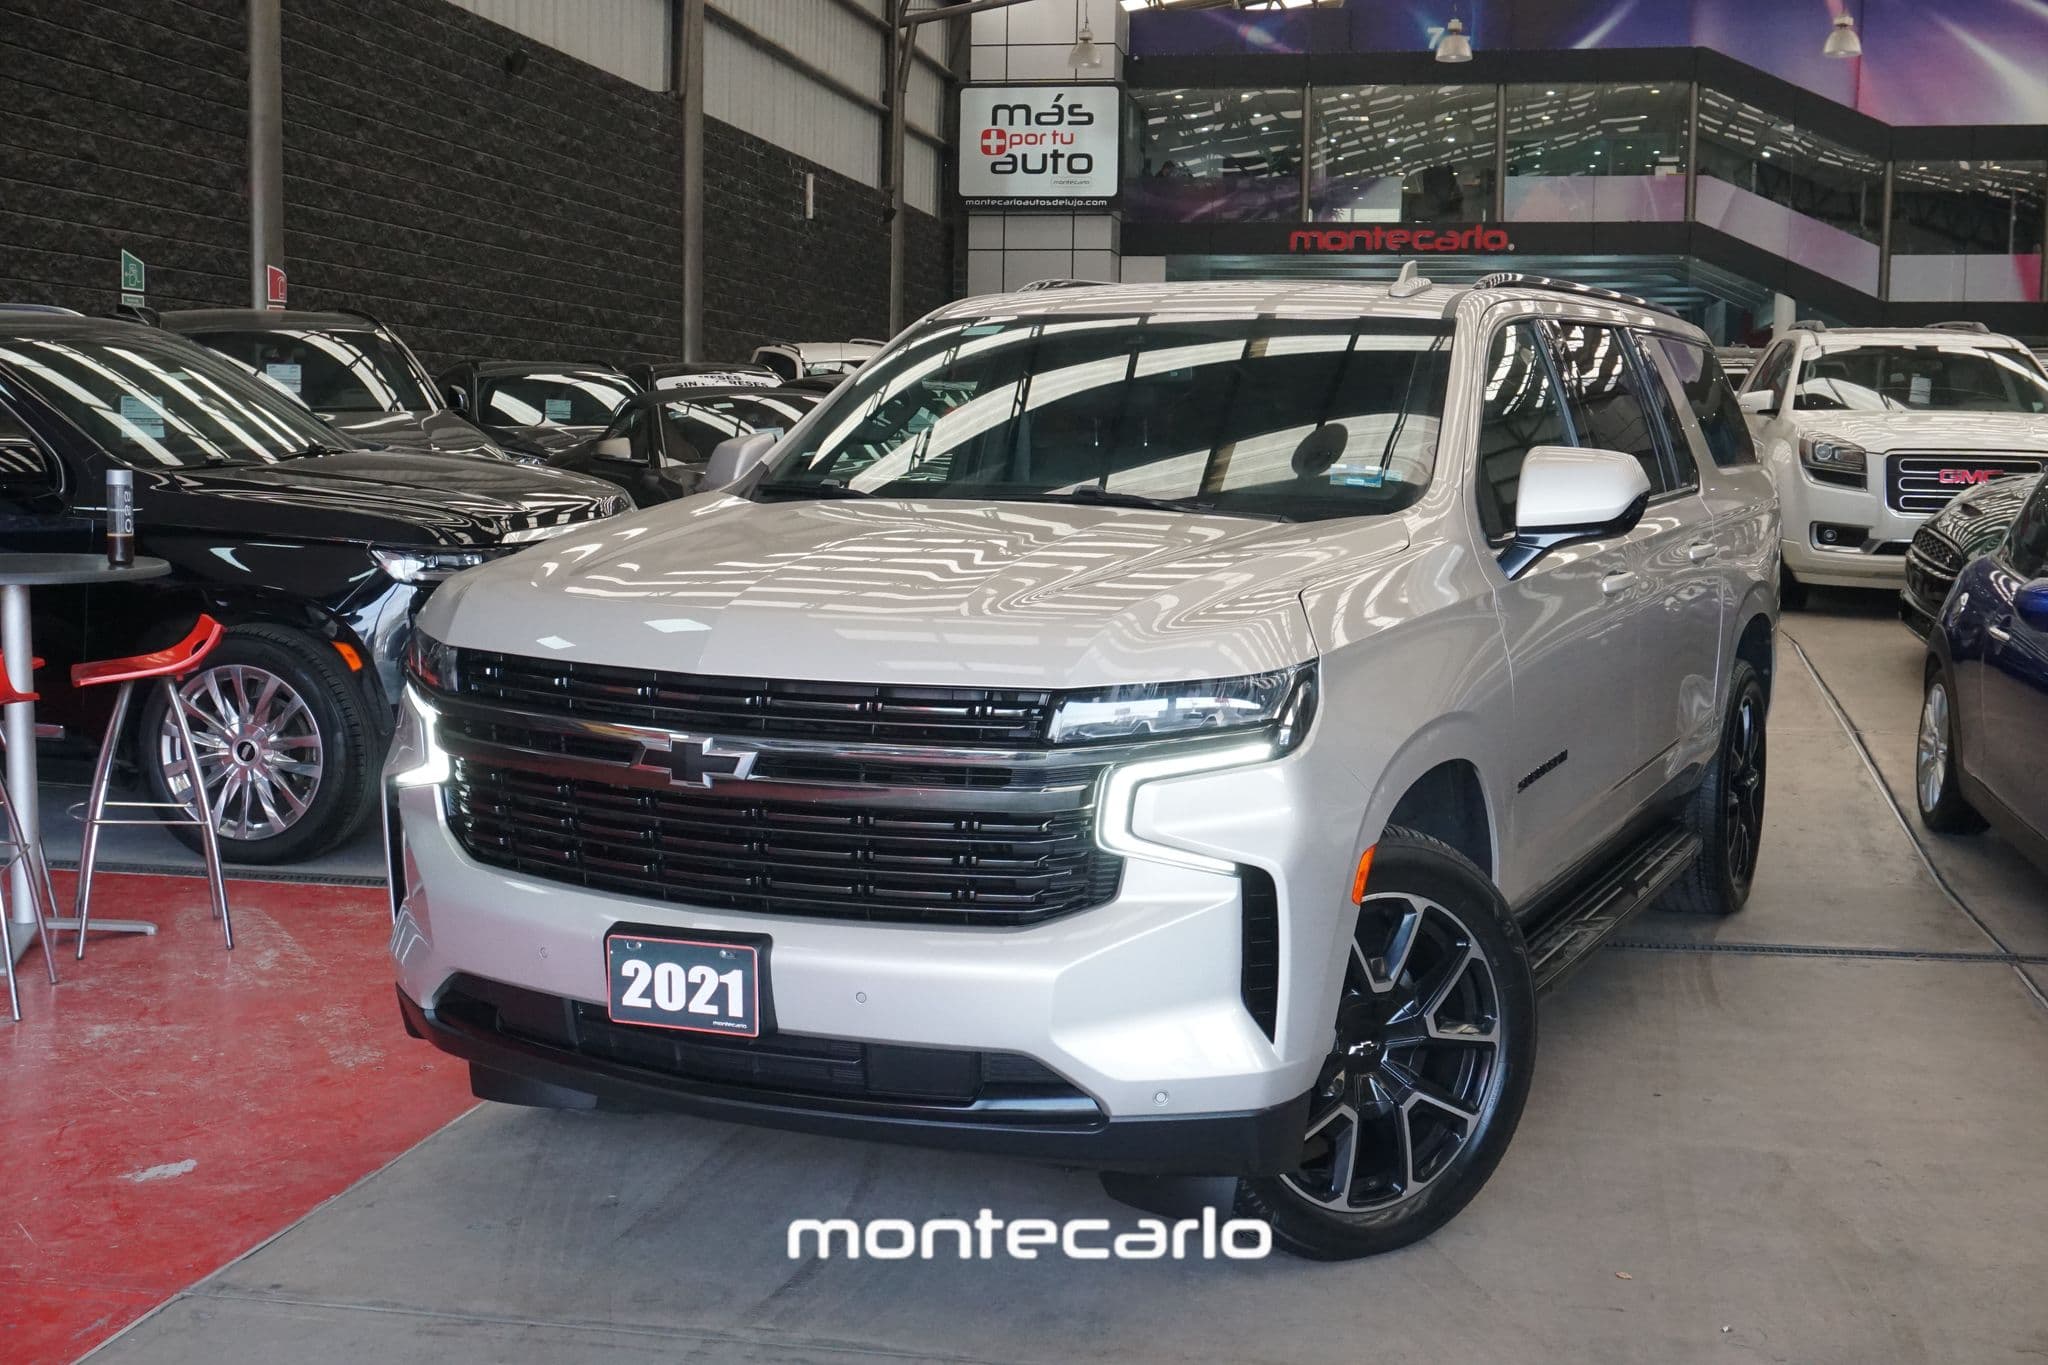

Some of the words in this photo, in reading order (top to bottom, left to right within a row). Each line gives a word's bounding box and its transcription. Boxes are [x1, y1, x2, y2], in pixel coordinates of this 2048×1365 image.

[991, 93, 1095, 126] más
[1009, 133, 1047, 149] por
[1051, 130, 1075, 146] tu
[990, 149, 1094, 175] auto
[965, 198, 1108, 208] montecarloautosdelujo.com
[1289, 224, 1509, 251] montecarlo
[674, 381, 699, 389] SIN
[621, 959, 744, 1019] 2021
